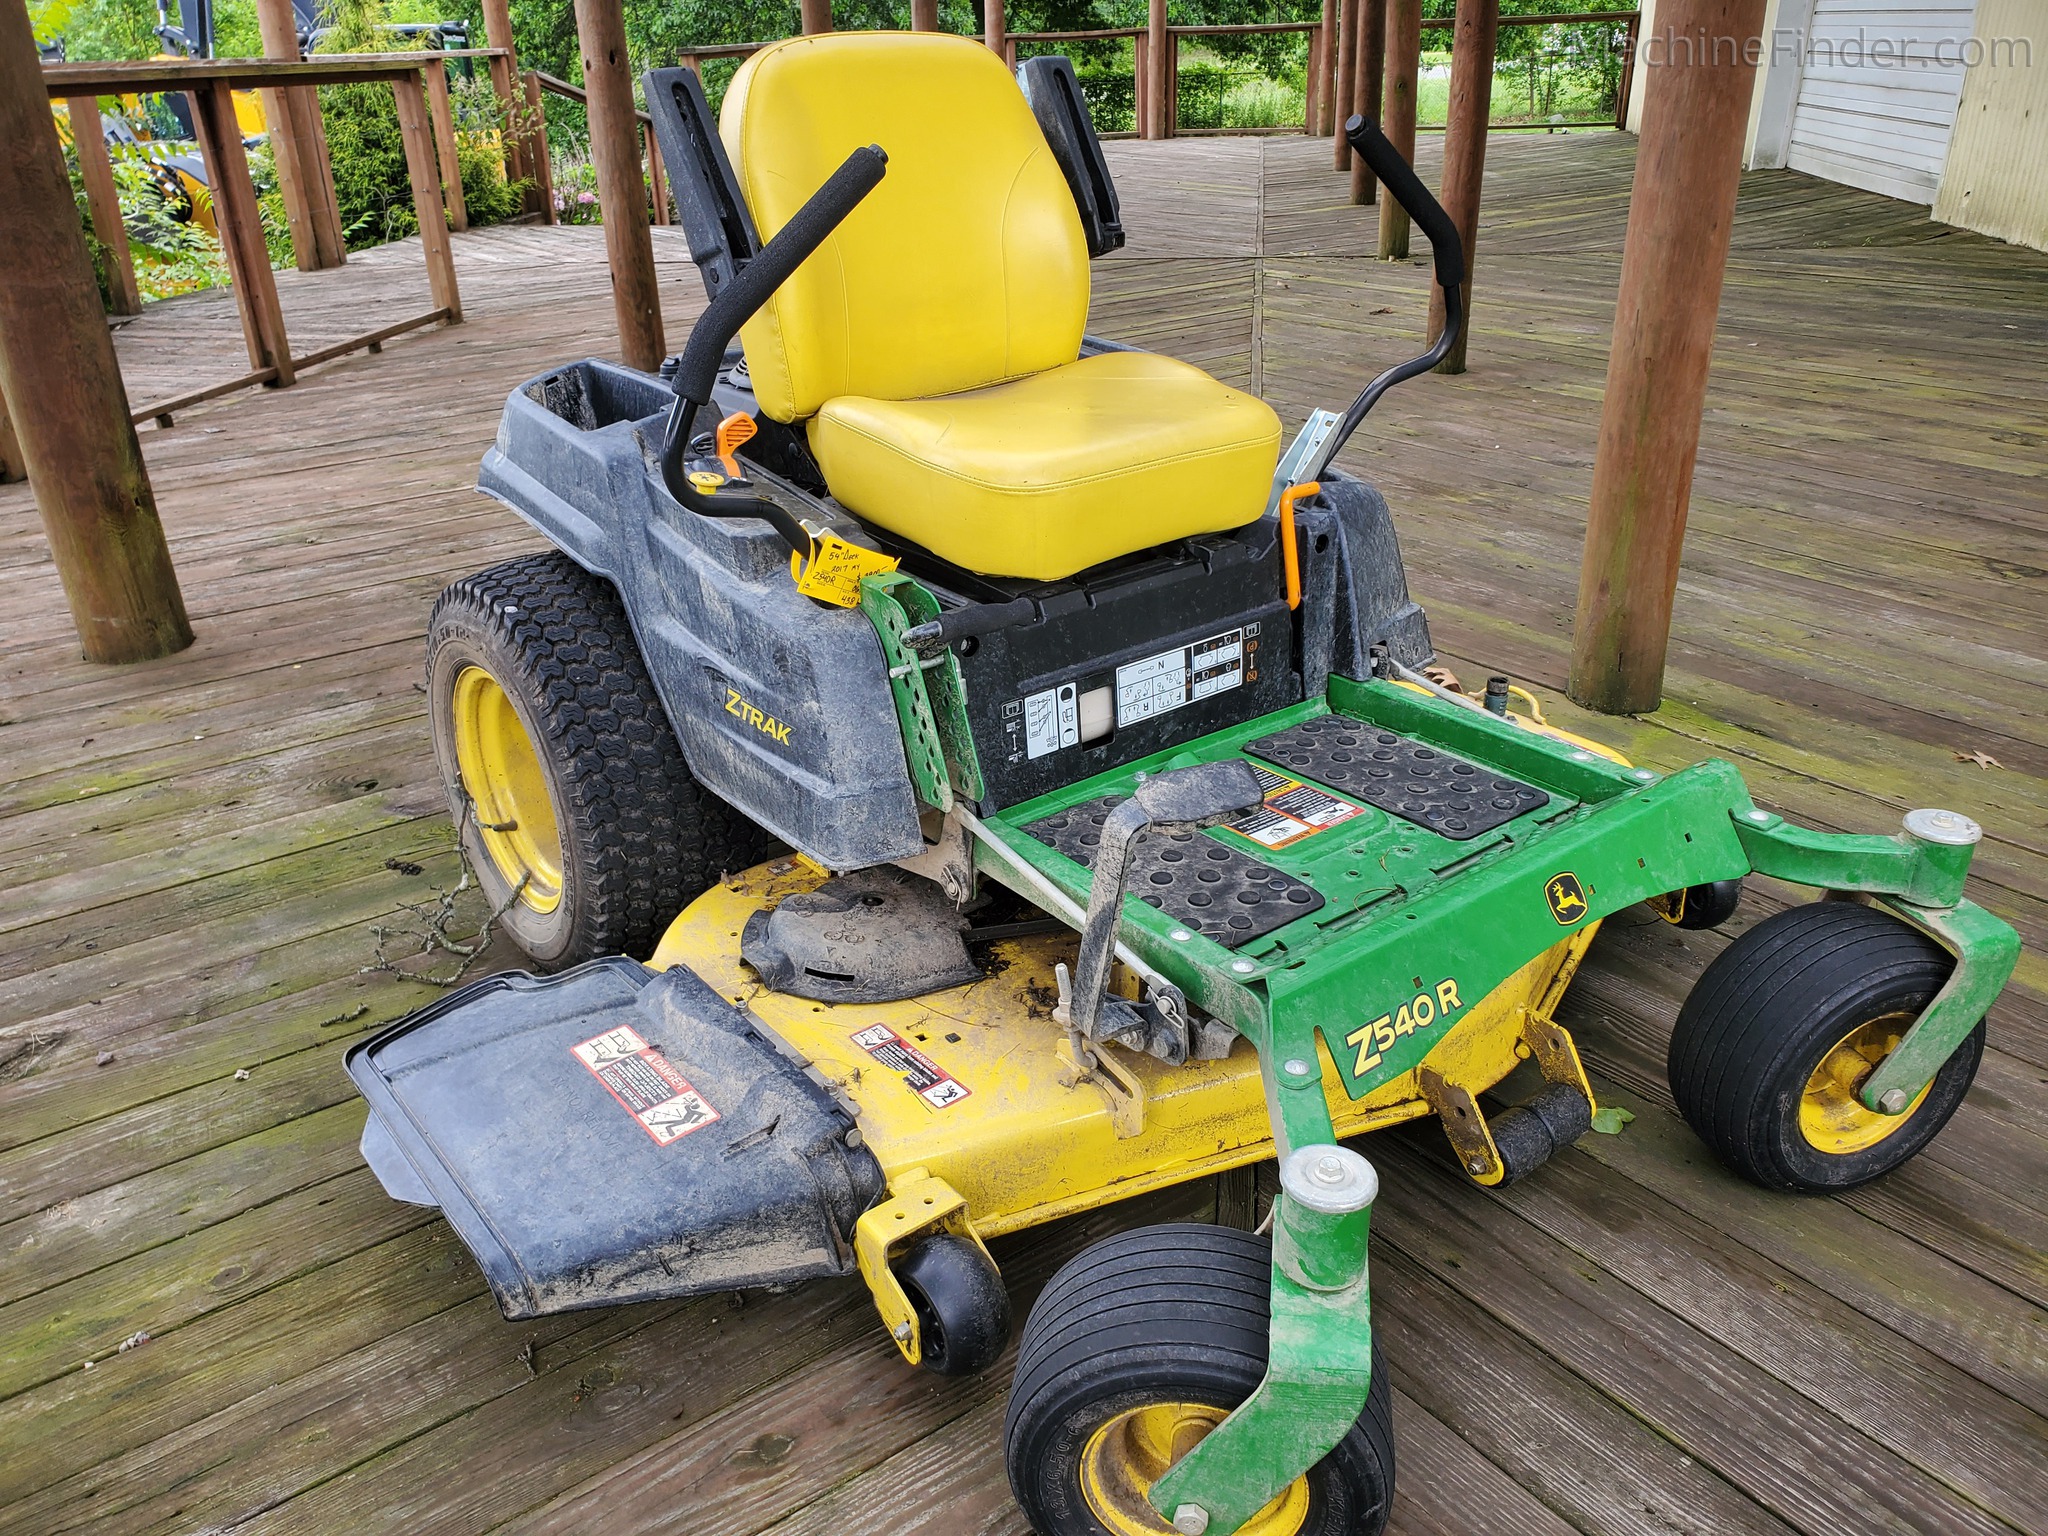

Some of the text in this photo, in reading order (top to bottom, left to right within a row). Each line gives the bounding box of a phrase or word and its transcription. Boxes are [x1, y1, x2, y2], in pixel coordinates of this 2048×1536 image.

[725, 688, 792, 746] ZTRAK
[652, 1059, 687, 1090] DANGER
[911, 1050, 938, 1071] DANGER
